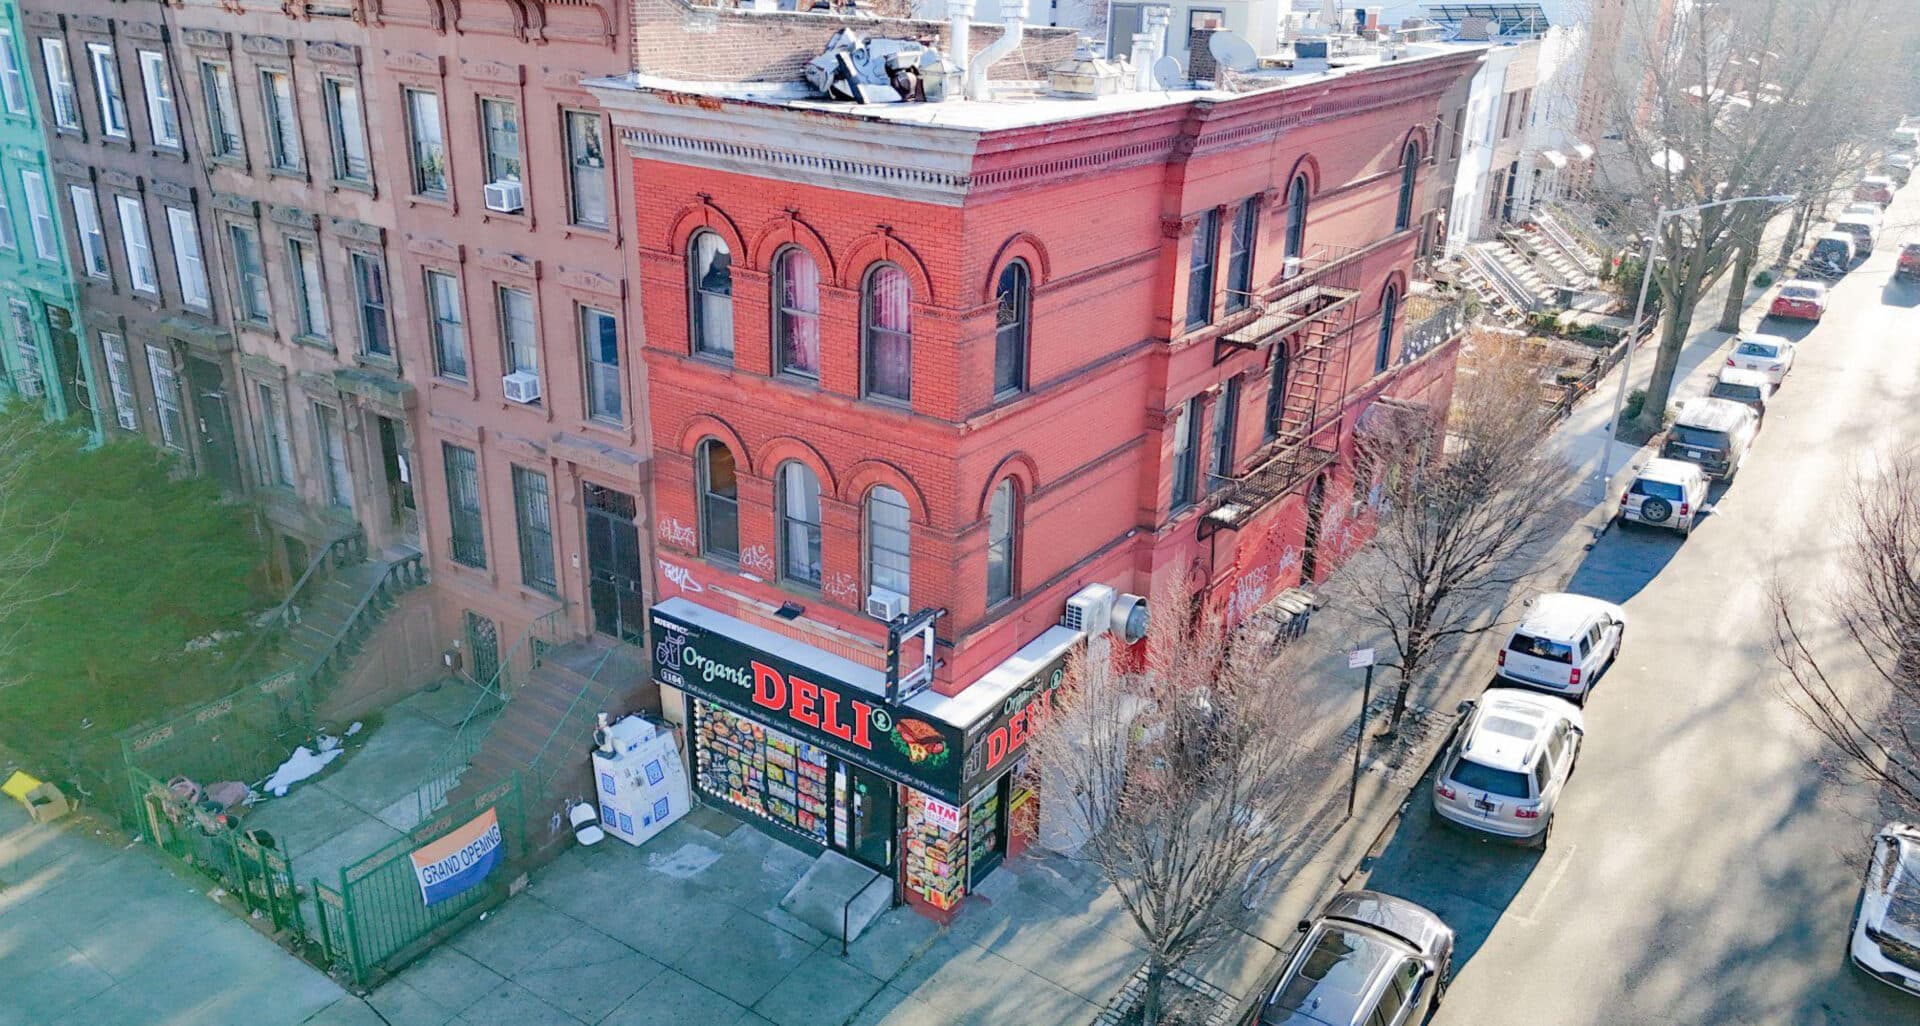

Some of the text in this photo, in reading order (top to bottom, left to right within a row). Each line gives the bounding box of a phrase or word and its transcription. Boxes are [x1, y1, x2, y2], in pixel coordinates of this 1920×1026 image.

[683, 647, 752, 688] Organic
[751, 661, 872, 750] DELI
[927, 802, 957, 822] ATM
[422, 826, 500, 885] GRAND OPENING
